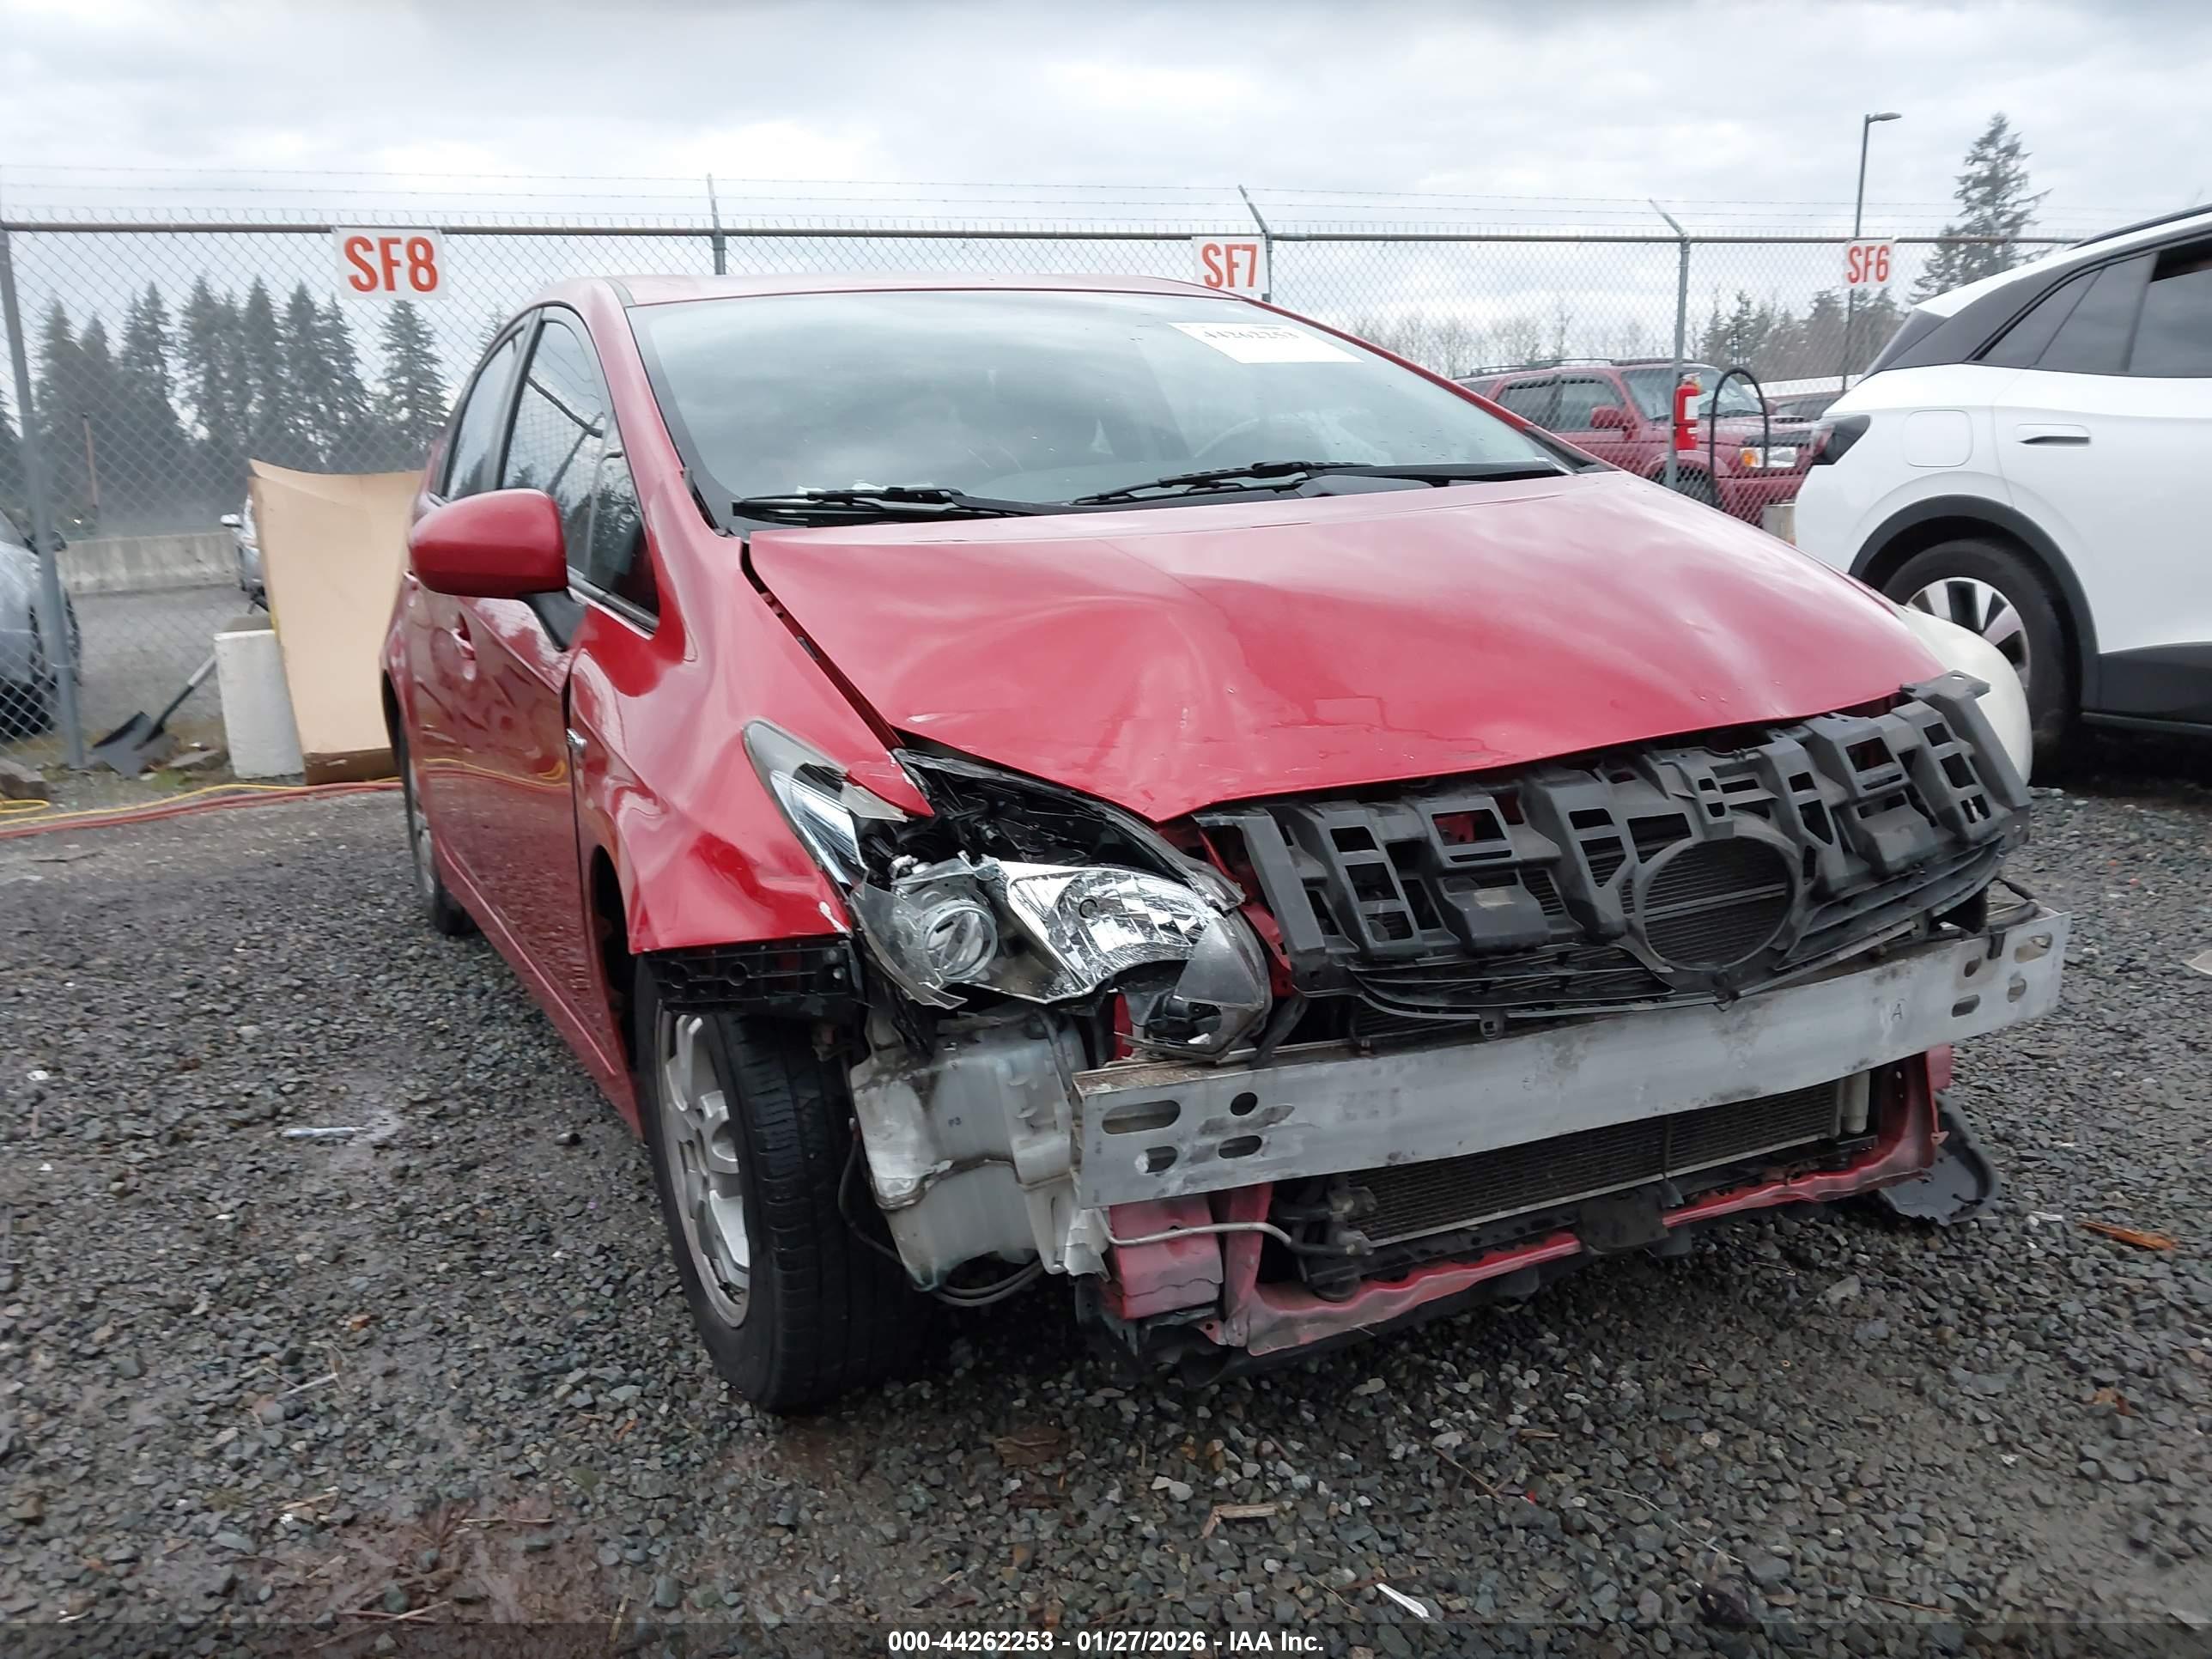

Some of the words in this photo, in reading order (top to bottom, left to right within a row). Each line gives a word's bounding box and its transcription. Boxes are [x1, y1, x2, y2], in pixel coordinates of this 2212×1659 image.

[344, 236, 439, 292] SF8
[1202, 243, 1257, 288] SF7
[1848, 245, 1890, 283] SF6
